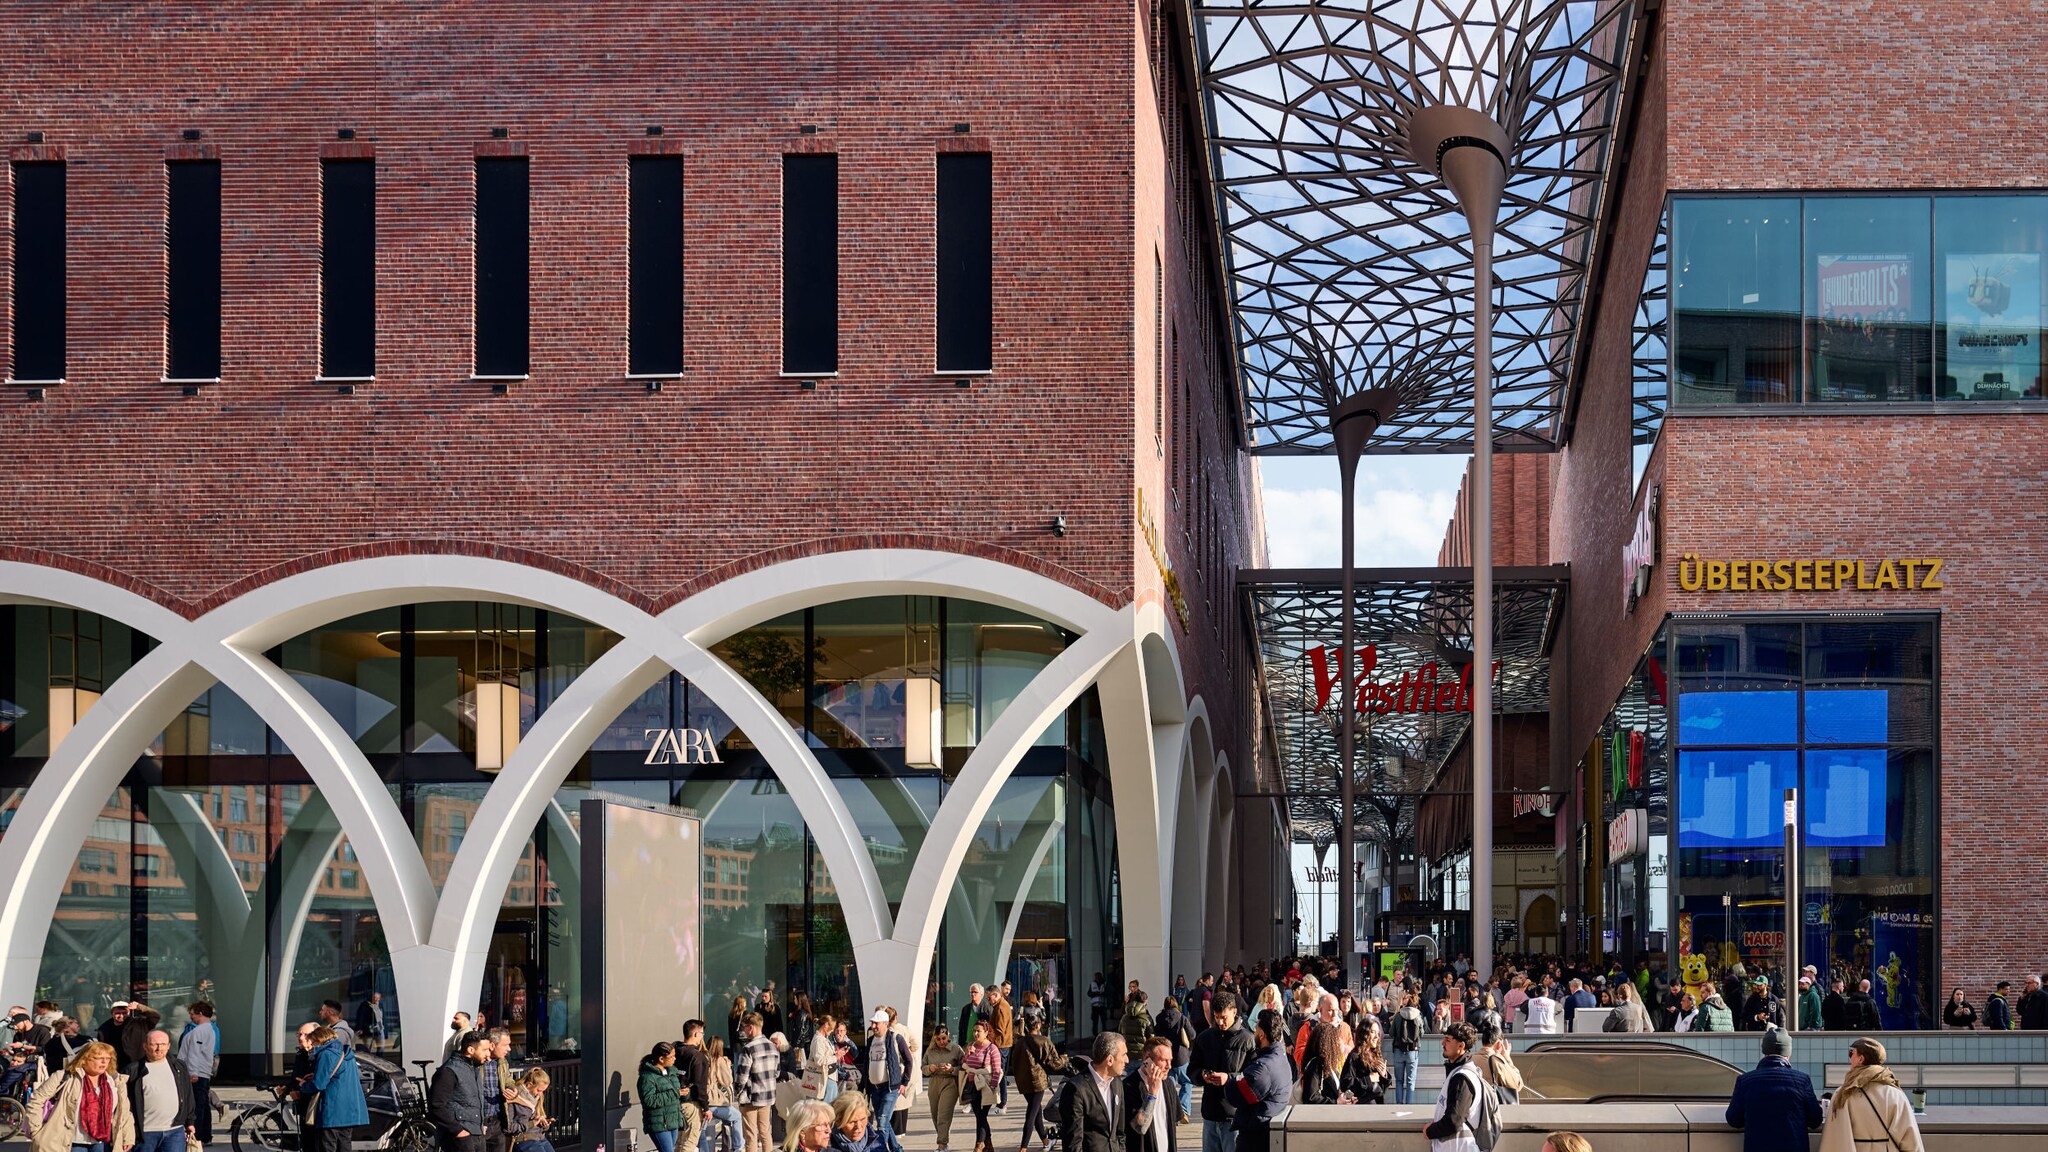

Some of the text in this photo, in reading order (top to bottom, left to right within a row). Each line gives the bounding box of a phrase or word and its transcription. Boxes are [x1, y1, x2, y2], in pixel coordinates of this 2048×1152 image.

[1679, 552, 1944, 592] ÜBERSEEPLATZ
[644, 728, 725, 765] ZARA
[1744, 931, 1786, 947] HARIB
